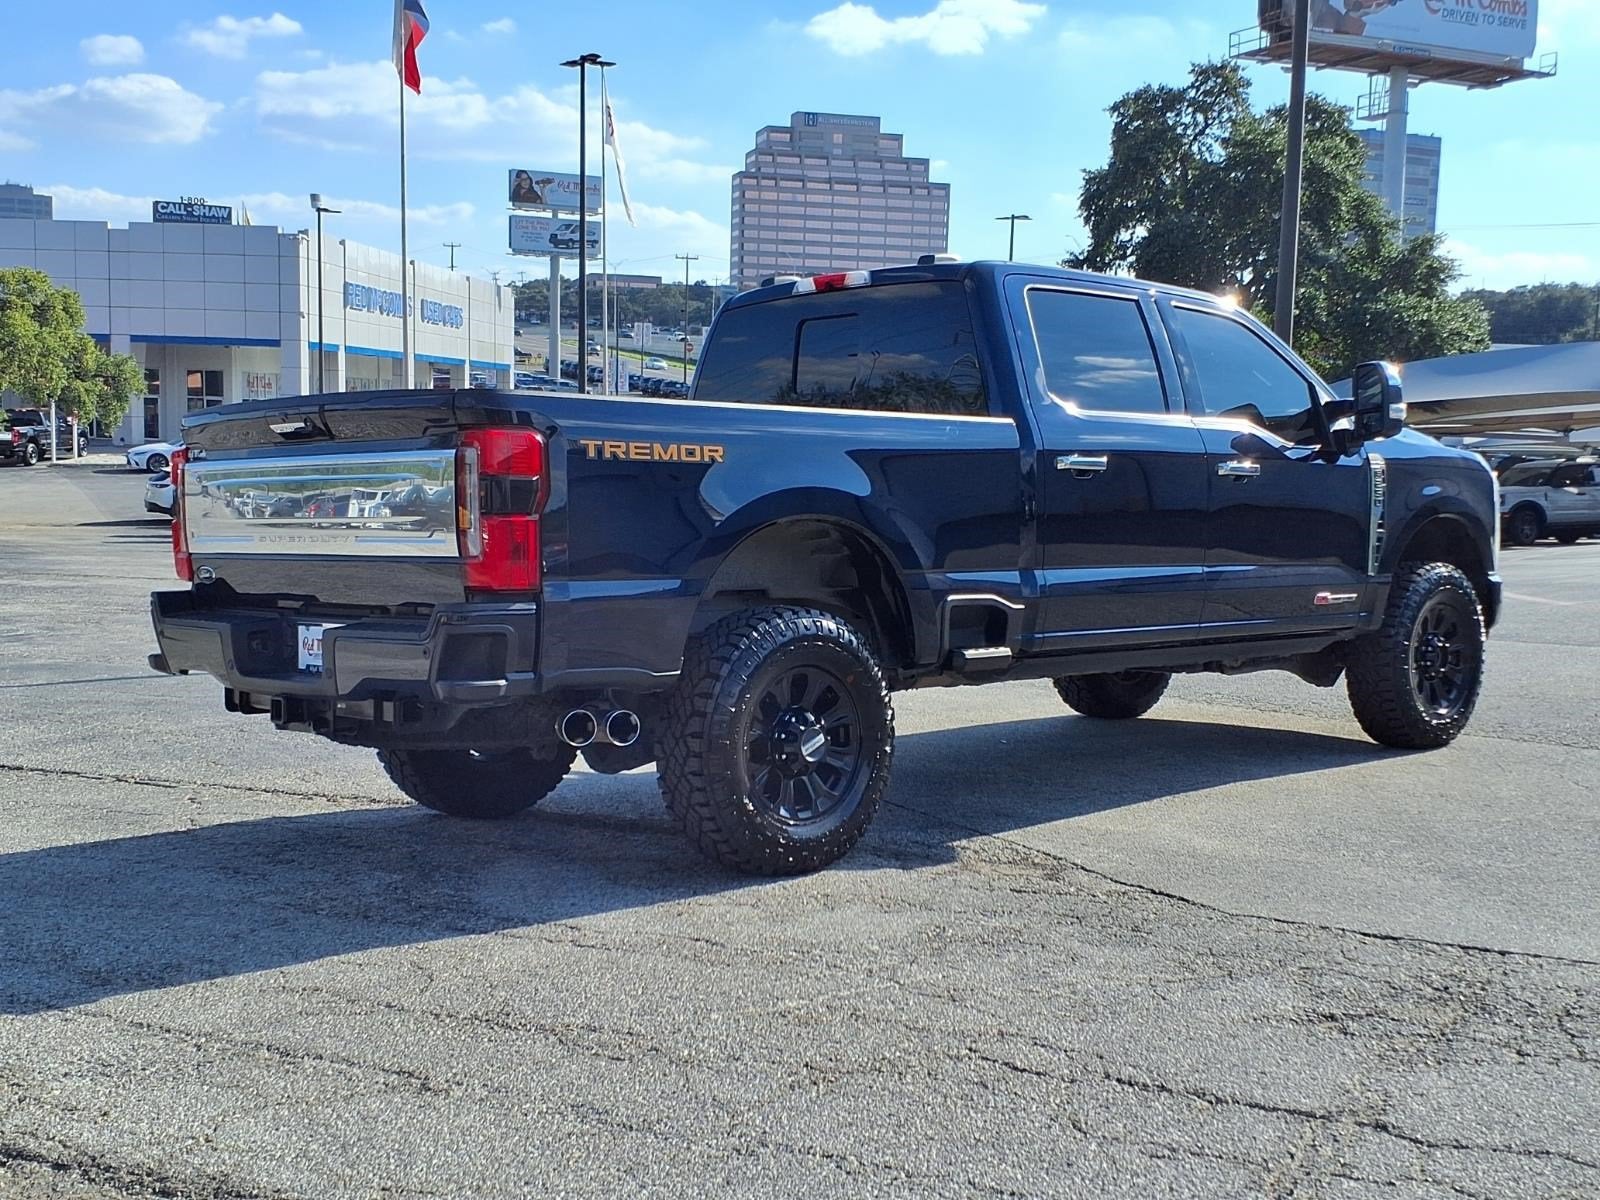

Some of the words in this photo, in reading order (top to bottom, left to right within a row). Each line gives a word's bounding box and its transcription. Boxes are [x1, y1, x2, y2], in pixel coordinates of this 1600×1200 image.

[1441, 8, 1479, 23] DRIVEN
[1481, 14, 1496, 25] TO
[1496, 16, 1528, 30] SERVE
[420, 298, 442, 326] USED
[442, 304, 464, 330] CARS
[579, 439, 725, 463] TREMOR
[257, 534, 306, 544] SUPER
[309, 534, 351, 544] DUTY
